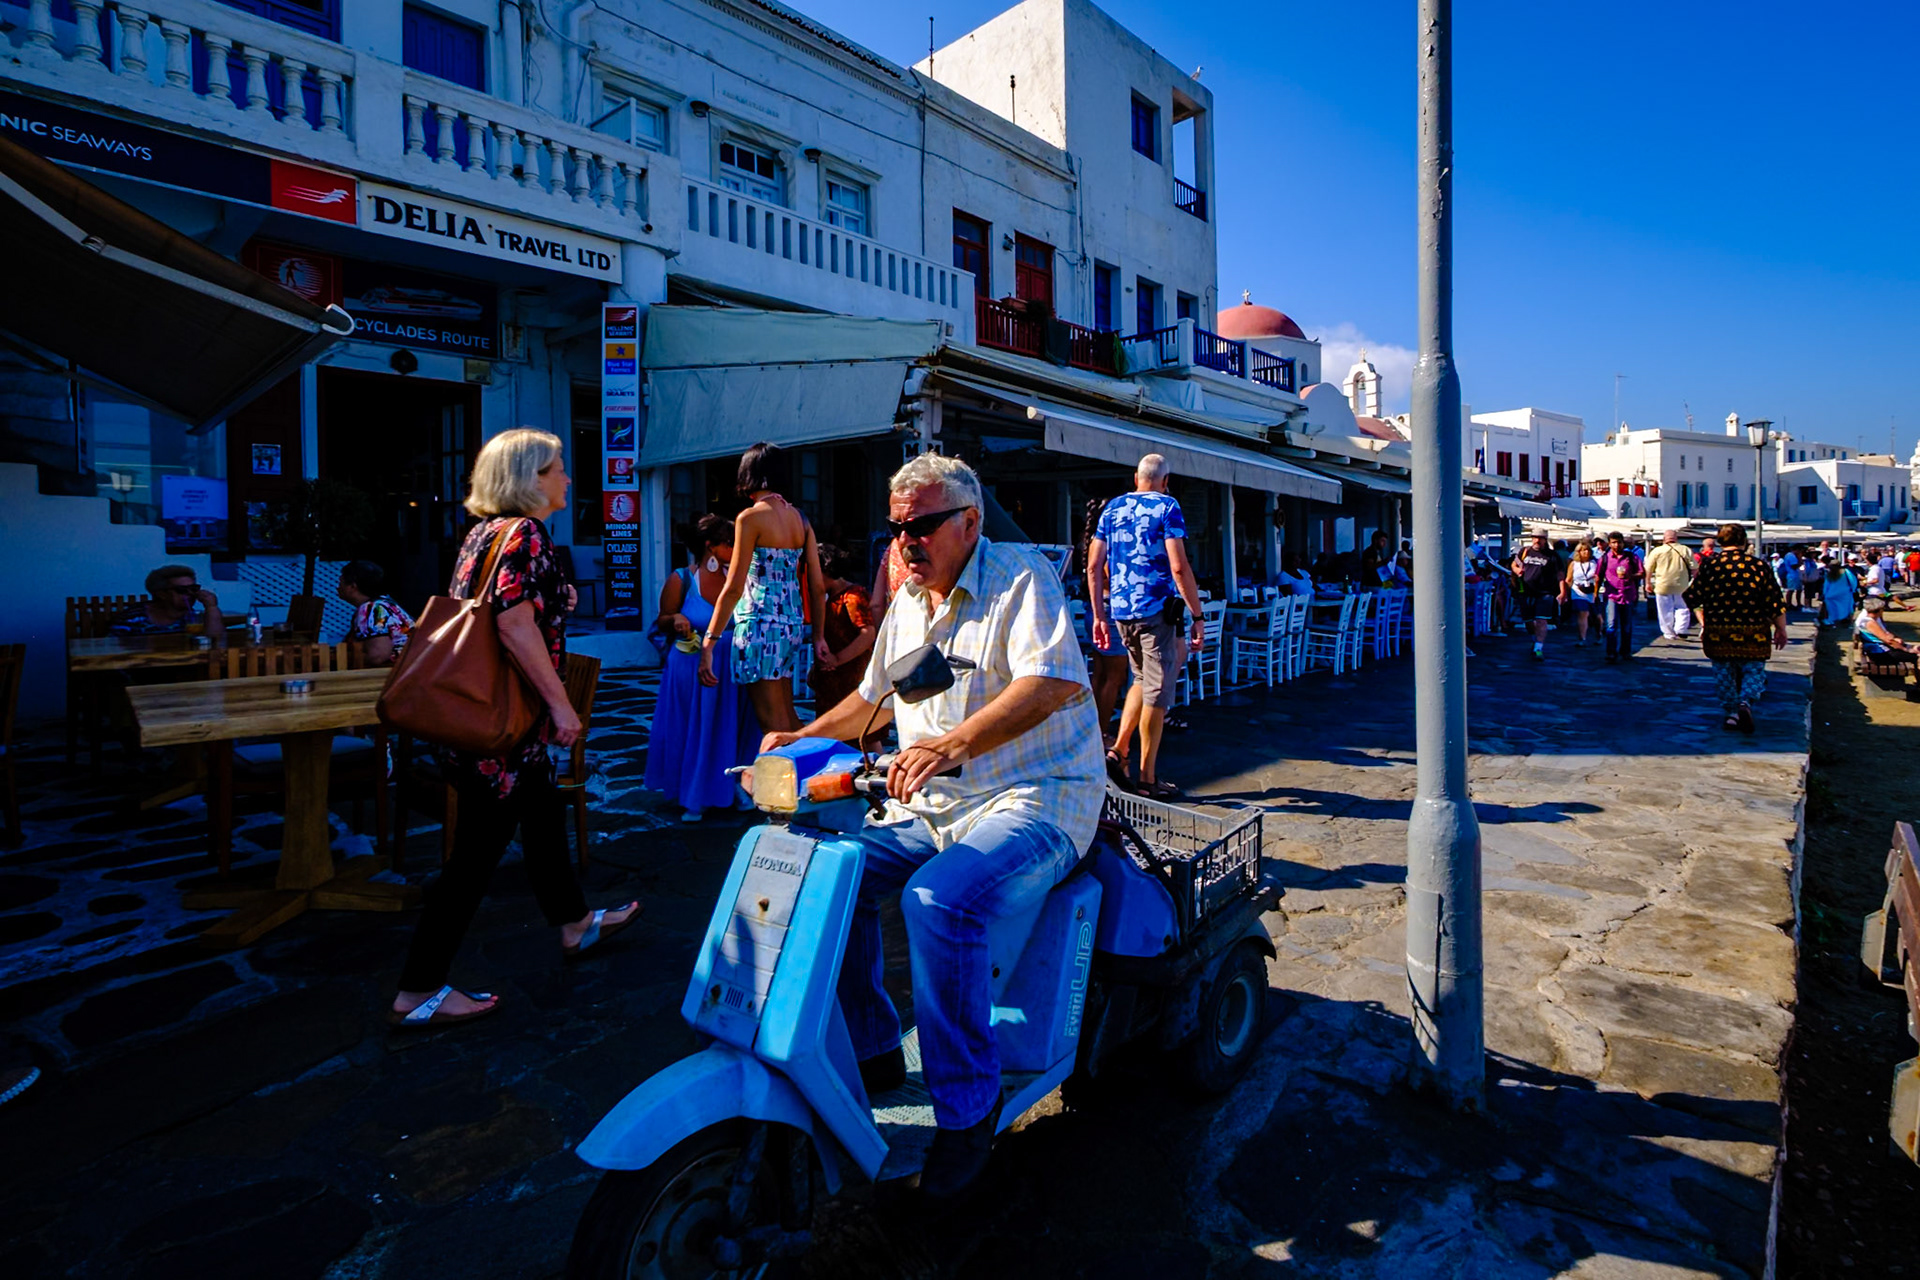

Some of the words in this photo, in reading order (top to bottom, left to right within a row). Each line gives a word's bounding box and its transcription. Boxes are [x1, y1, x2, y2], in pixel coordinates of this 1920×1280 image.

[51, 125, 153, 161] SEAWAYS
[373, 195, 488, 245] DELIA
[495, 229, 572, 263] TRAVEL
[578, 248, 611, 270] LTD
[354, 317, 438, 341] CYCLADES
[441, 331, 491, 350] ROUTE
[606, 543, 638, 553] CYCLADES
[612, 554, 632, 564] ROUTE
[751, 855, 802, 877] HONDA
